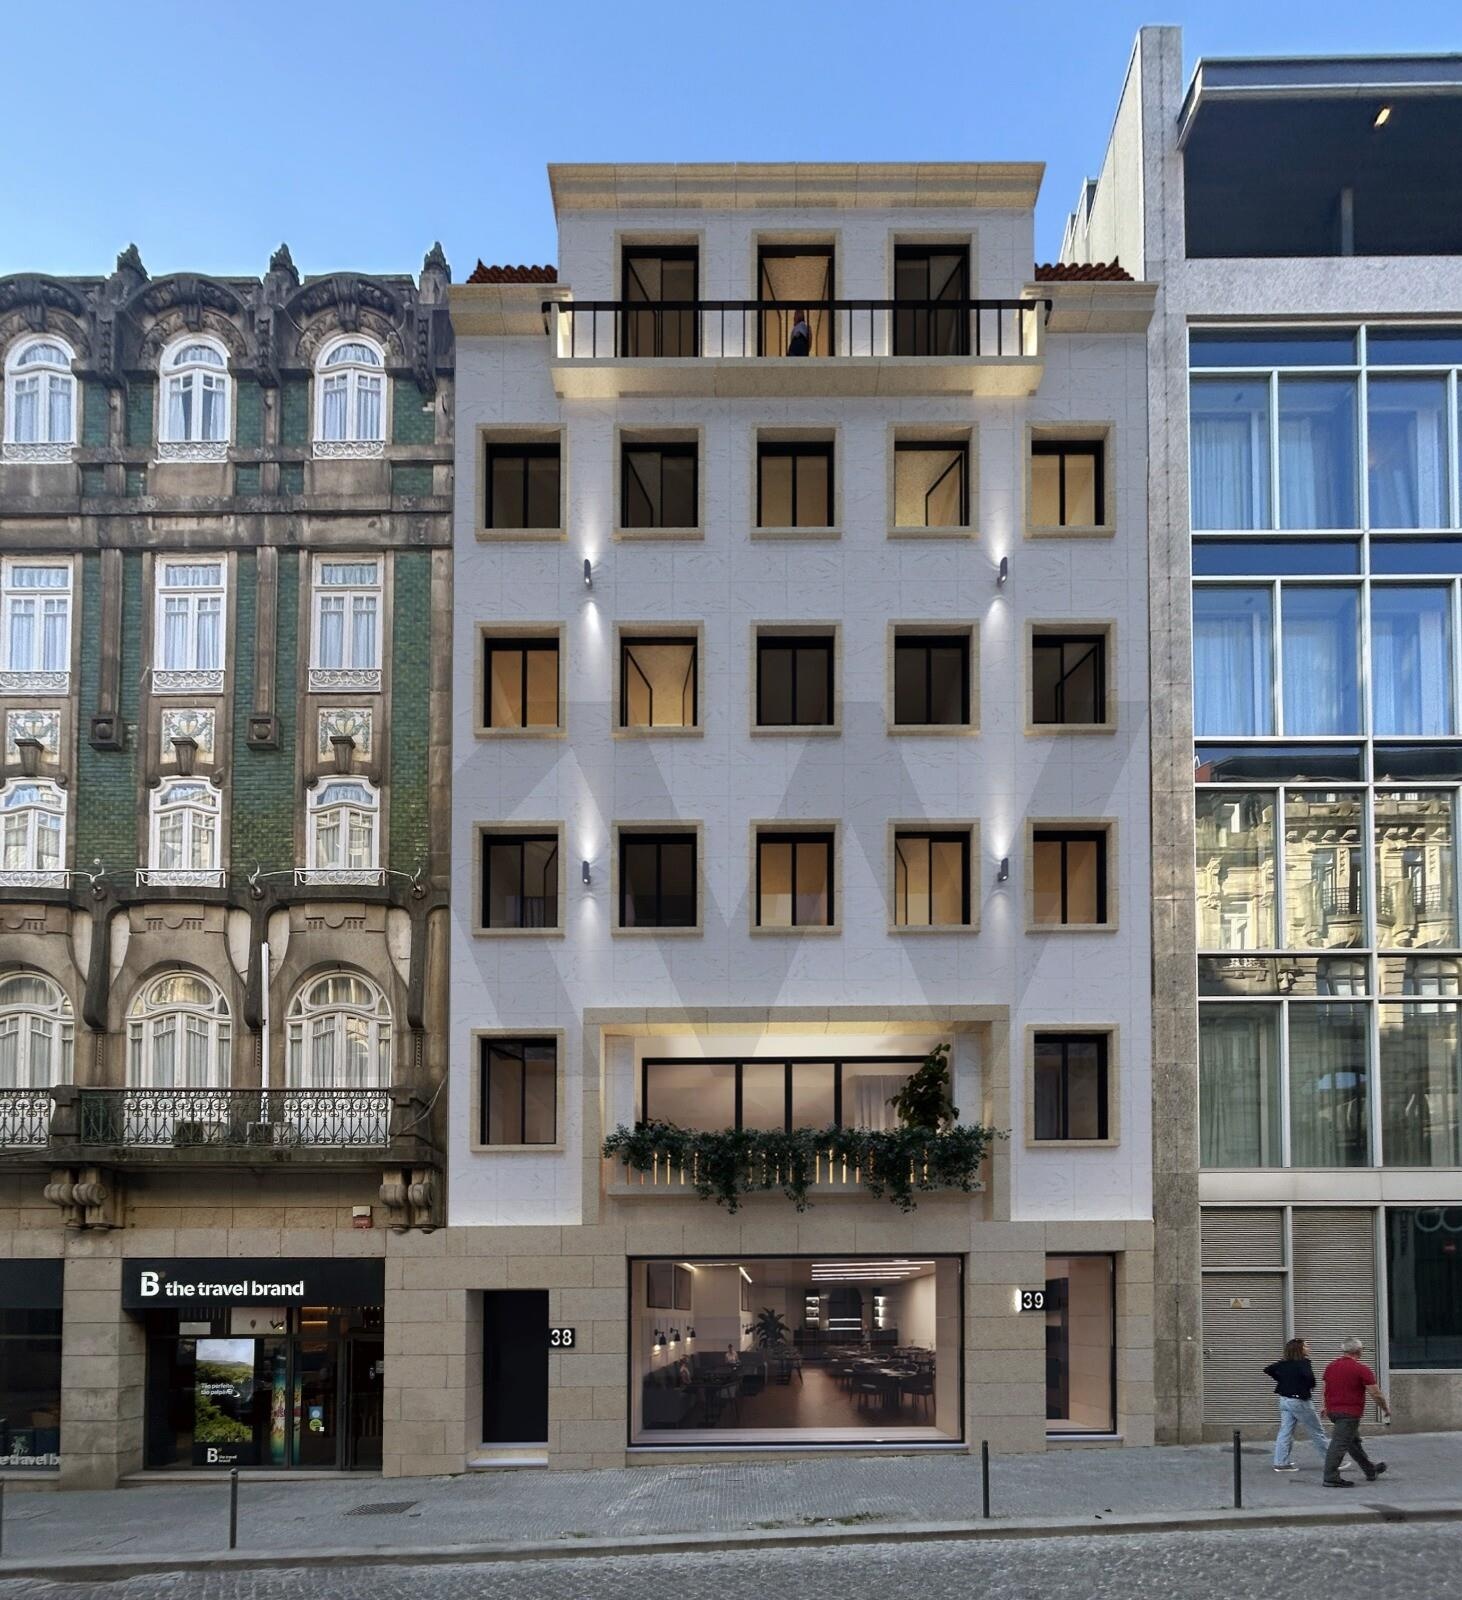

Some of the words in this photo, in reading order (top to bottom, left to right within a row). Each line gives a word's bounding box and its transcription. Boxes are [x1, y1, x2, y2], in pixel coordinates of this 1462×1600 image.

[140, 1271, 160, 1297] B
[165, 1281, 195, 1297] the
[197, 1280, 249, 1297] travel
[251, 1280, 304, 1297] brand
[1023, 1292, 1044, 1309] 39
[551, 1329, 572, 1346] 38
[207, 1447, 218, 1463] B
